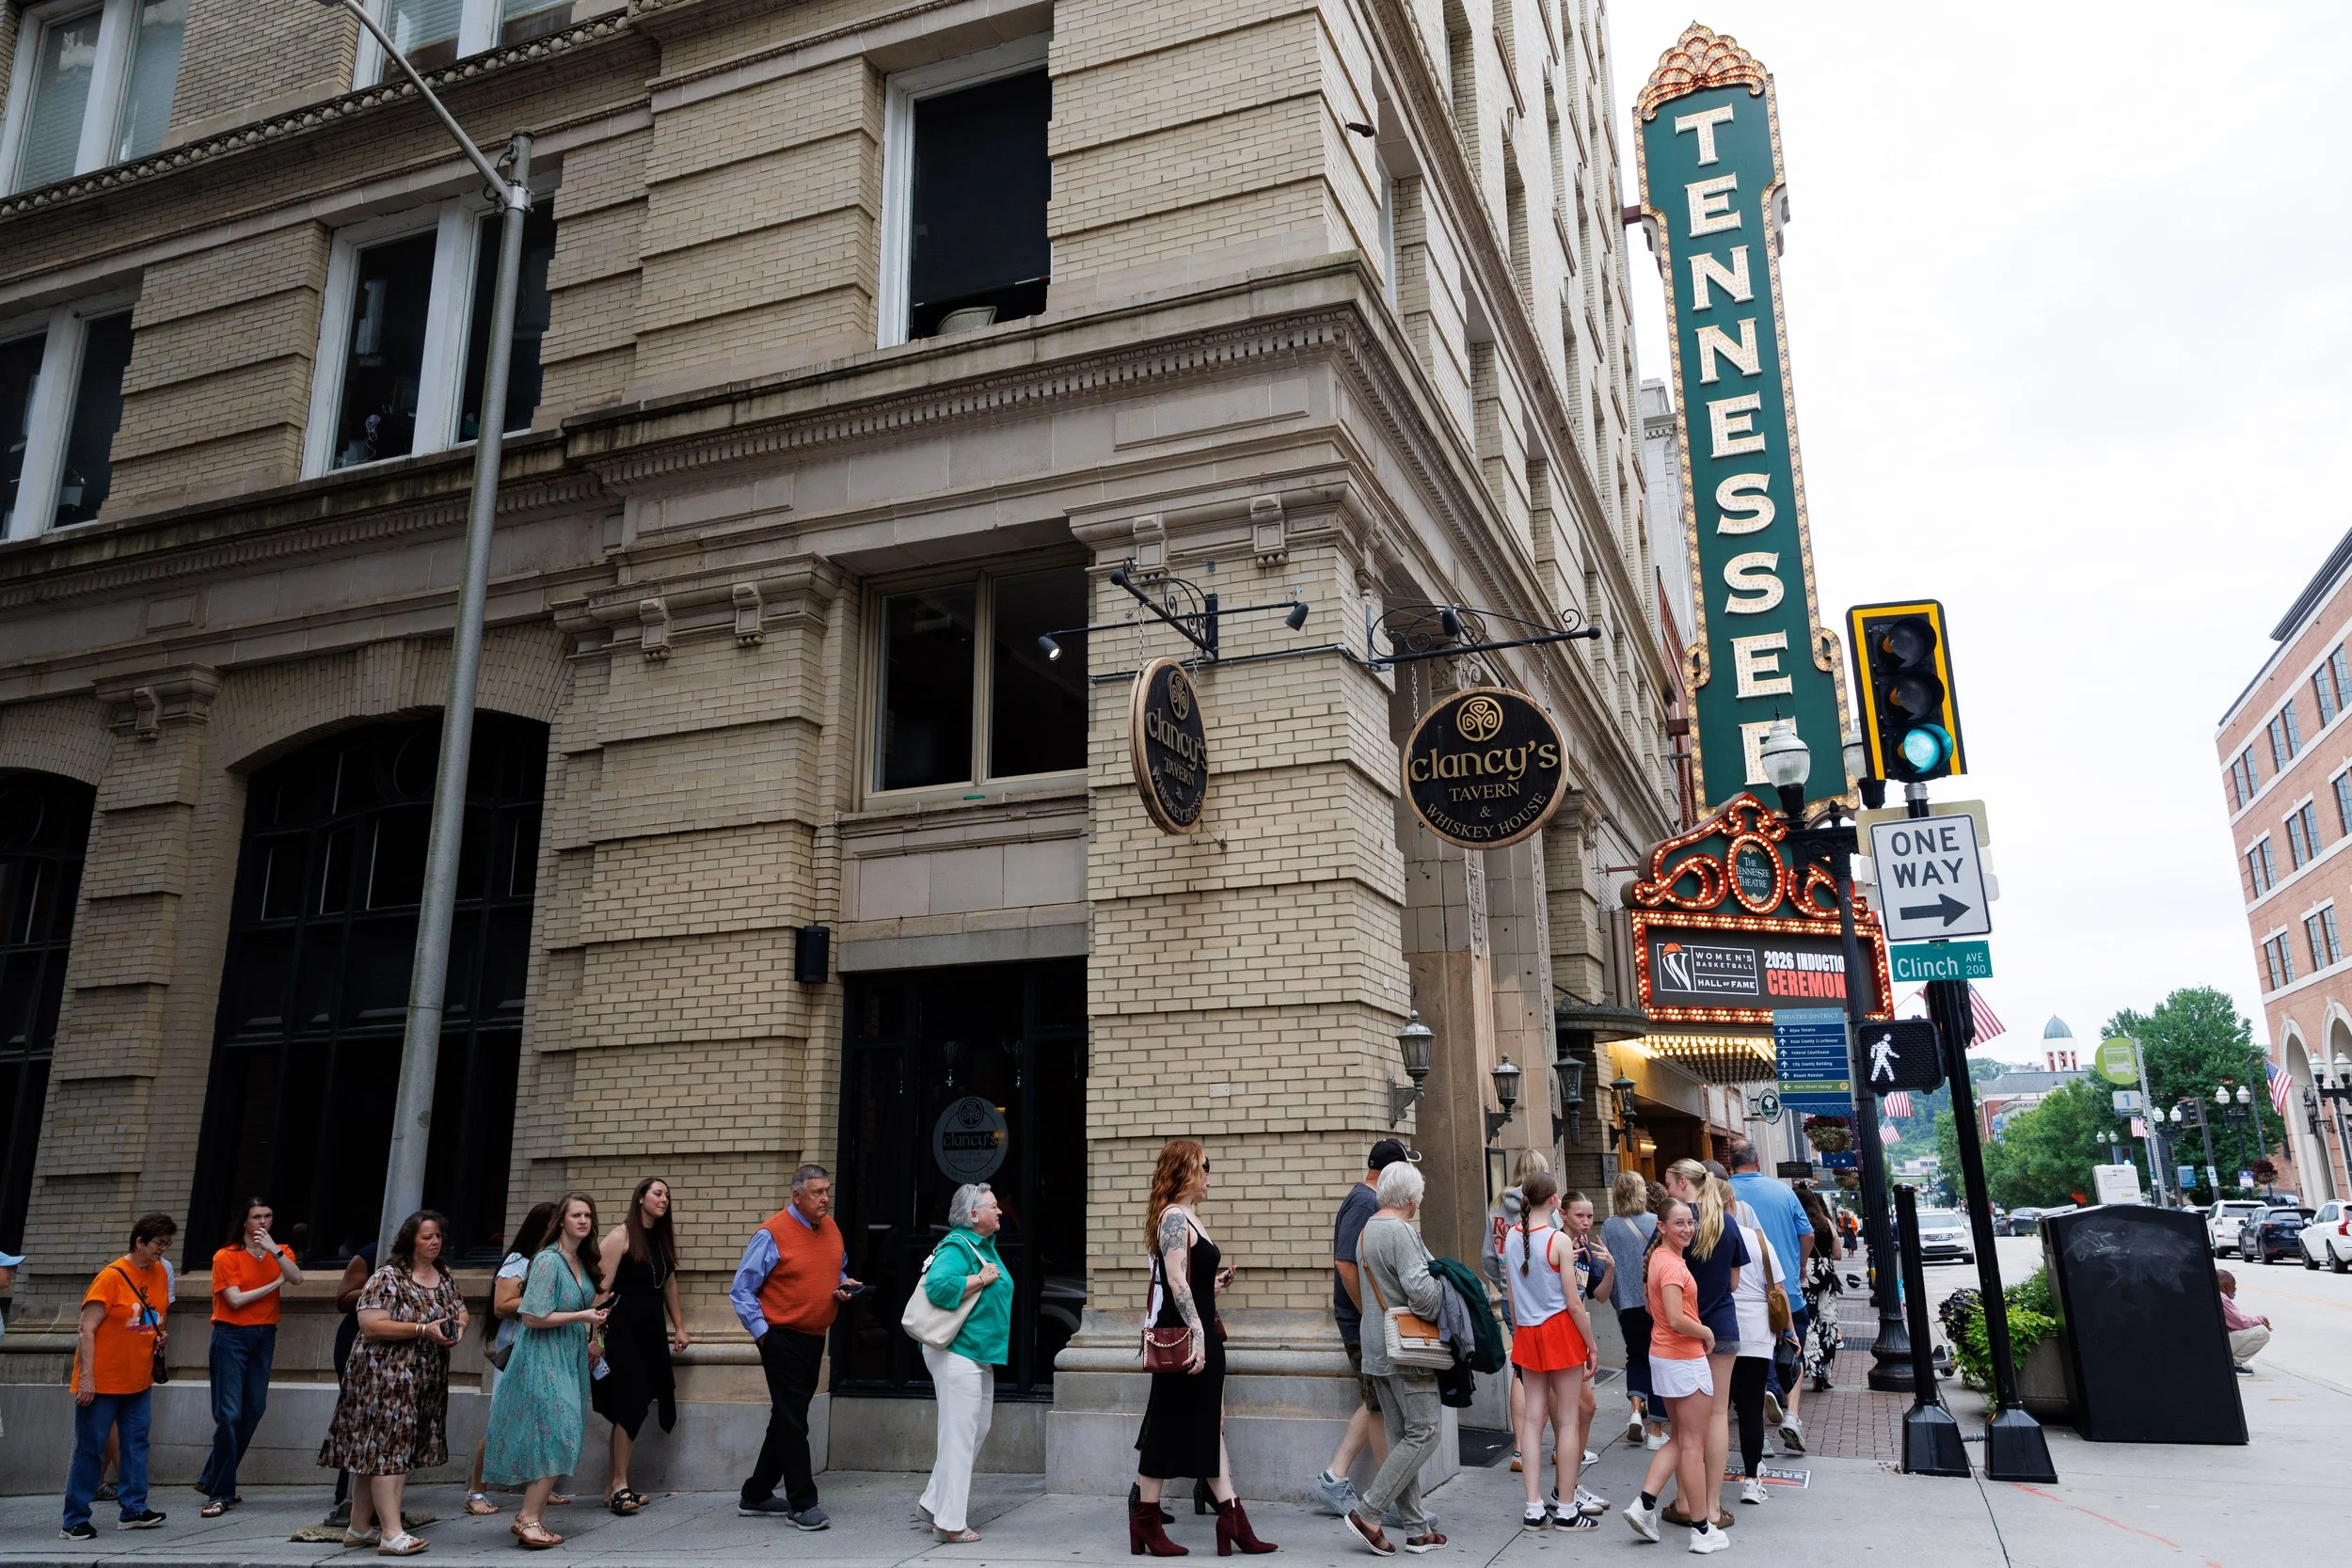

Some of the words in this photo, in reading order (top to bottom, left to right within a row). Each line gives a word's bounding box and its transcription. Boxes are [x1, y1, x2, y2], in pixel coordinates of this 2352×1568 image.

[1675, 103, 1797, 786] TENNESSEE
[1145, 707, 1208, 771] clancy's
[1409, 739, 1559, 782] clancy's
[1163, 756, 1195, 787] TAVERN
[1152, 766, 1184, 821] WHISKEY
[1175, 786, 1184, 800] &
[1449, 782, 1520, 802] TAVERN
[1425, 803, 1495, 839] WHISKEY
[1498, 792, 1546, 835] HOUSE
[1480, 805, 1492, 818] &
[1891, 826, 1960, 857] ONE
[1743, 857, 1756, 867] THE
[1735, 865, 1770, 878] TENNESSEE
[1892, 858, 1963, 888] WAY
[1737, 876, 1768, 888] THEATRE
[1695, 952, 1753, 962] WOMEN'S
[1695, 961, 1754, 970] BASKETBALL
[1764, 951, 1794, 970] 2026
[1796, 952, 1845, 973] INDUCTIO
[1965, 952, 1984, 962] AVE
[1897, 956, 1959, 978] Clinch
[1966, 965, 1986, 974] 200
[1697, 978, 1723, 988] HALL
[1731, 980, 1755, 989] FAME
[1767, 970, 1847, 999] CEREMON
[2122, 1094, 2131, 1106] 1
[944, 1132, 997, 1148] clancy's
